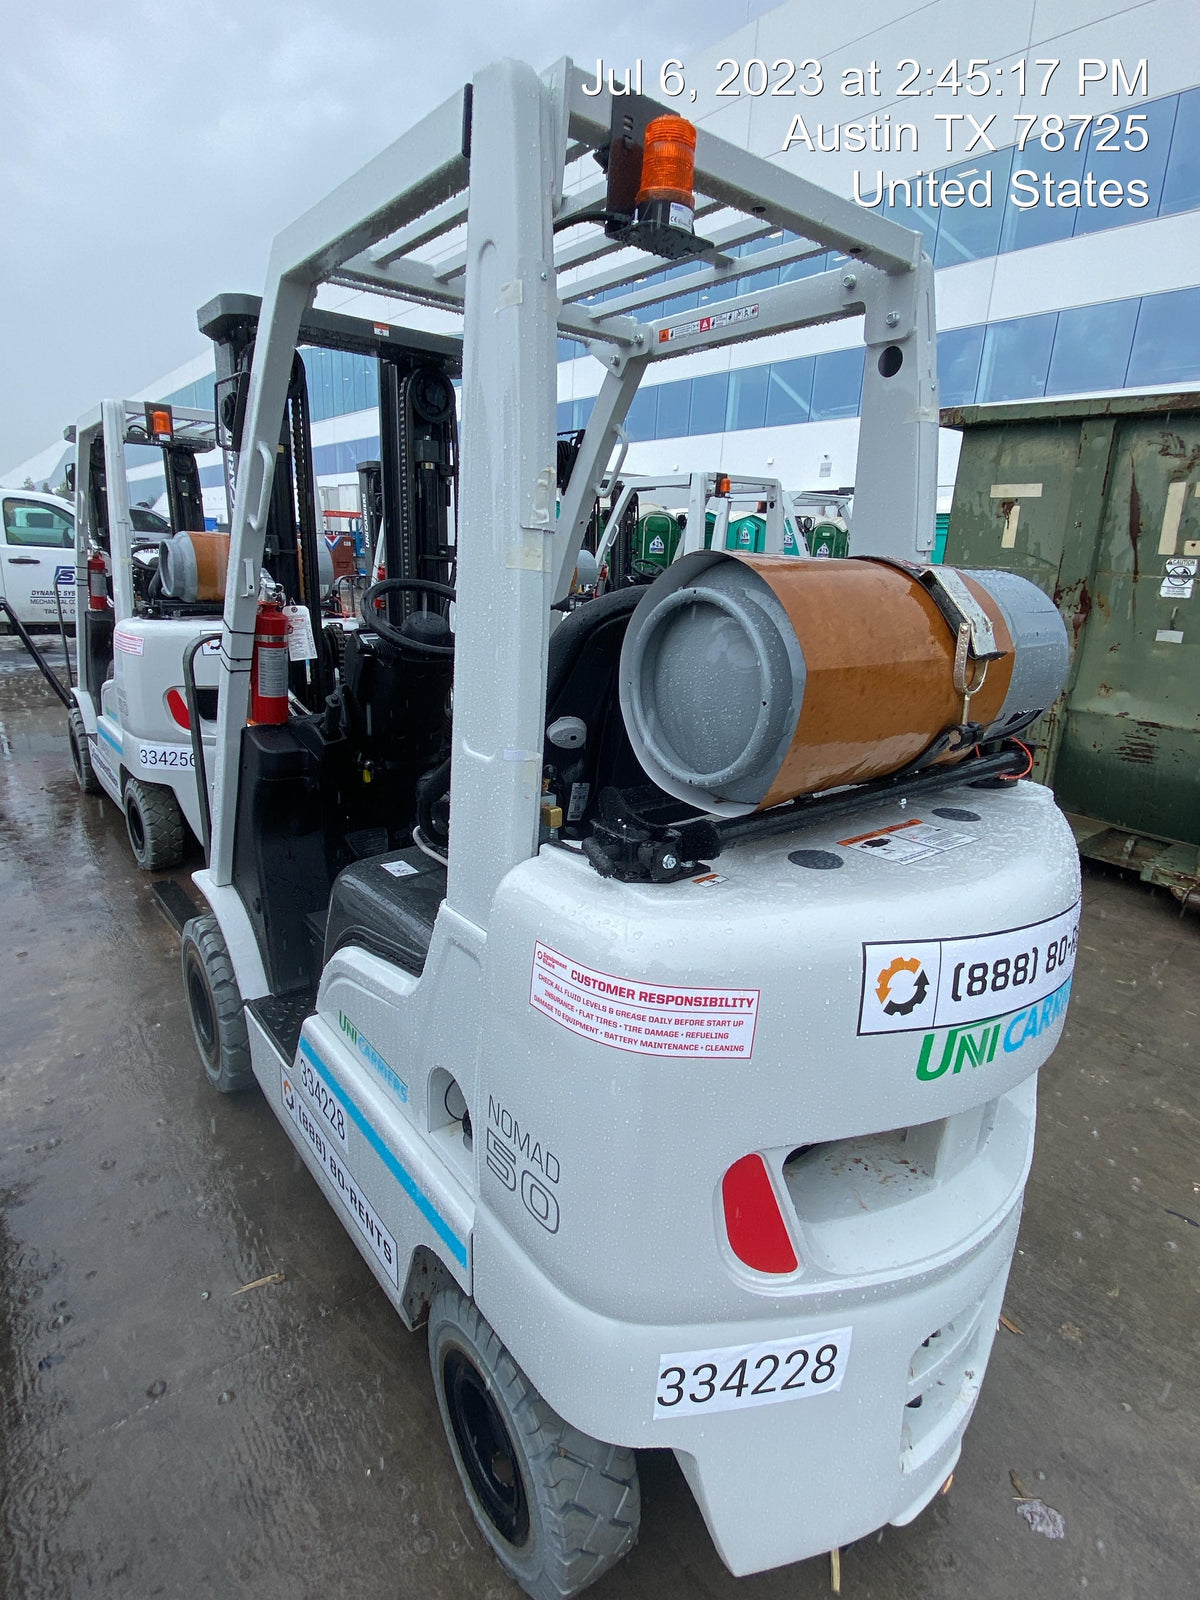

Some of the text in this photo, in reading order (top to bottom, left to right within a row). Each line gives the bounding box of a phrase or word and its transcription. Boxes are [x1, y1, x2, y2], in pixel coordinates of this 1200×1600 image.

[140, 749, 196, 768] 334256
[538, 973, 555, 988] CHECK
[554, 983, 564, 994] ALL
[564, 989, 582, 1003] FLUID
[582, 998, 607, 1013] LEVELS
[608, 1007, 614, 1015] &
[615, 1009, 647, 1022] GREASE
[648, 1015, 673, 1025] DAILY
[674, 1018, 705, 1027] BEFORE
[570, 969, 755, 1008] CUSTOMER RESPONSIBILITY
[951, 947, 1038, 1002] (888)
[533, 994, 744, 1052] DAMAGE TO EQUIPMENT BATTERY MAINTENANCE CLEANING
[544, 989, 729, 1040] INSURANCE FLAT TIRES TIRE DAMAGE REFUELING
[338, 1008, 408, 1104] UNICARRIERS
[300, 1057, 346, 1142] 334228
[488, 1094, 561, 1185] NOMAD
[298, 1104, 393, 1266] (888) 80-RENTS
[486, 1127, 560, 1235] 50
[656, 1343, 839, 1407] 334228
